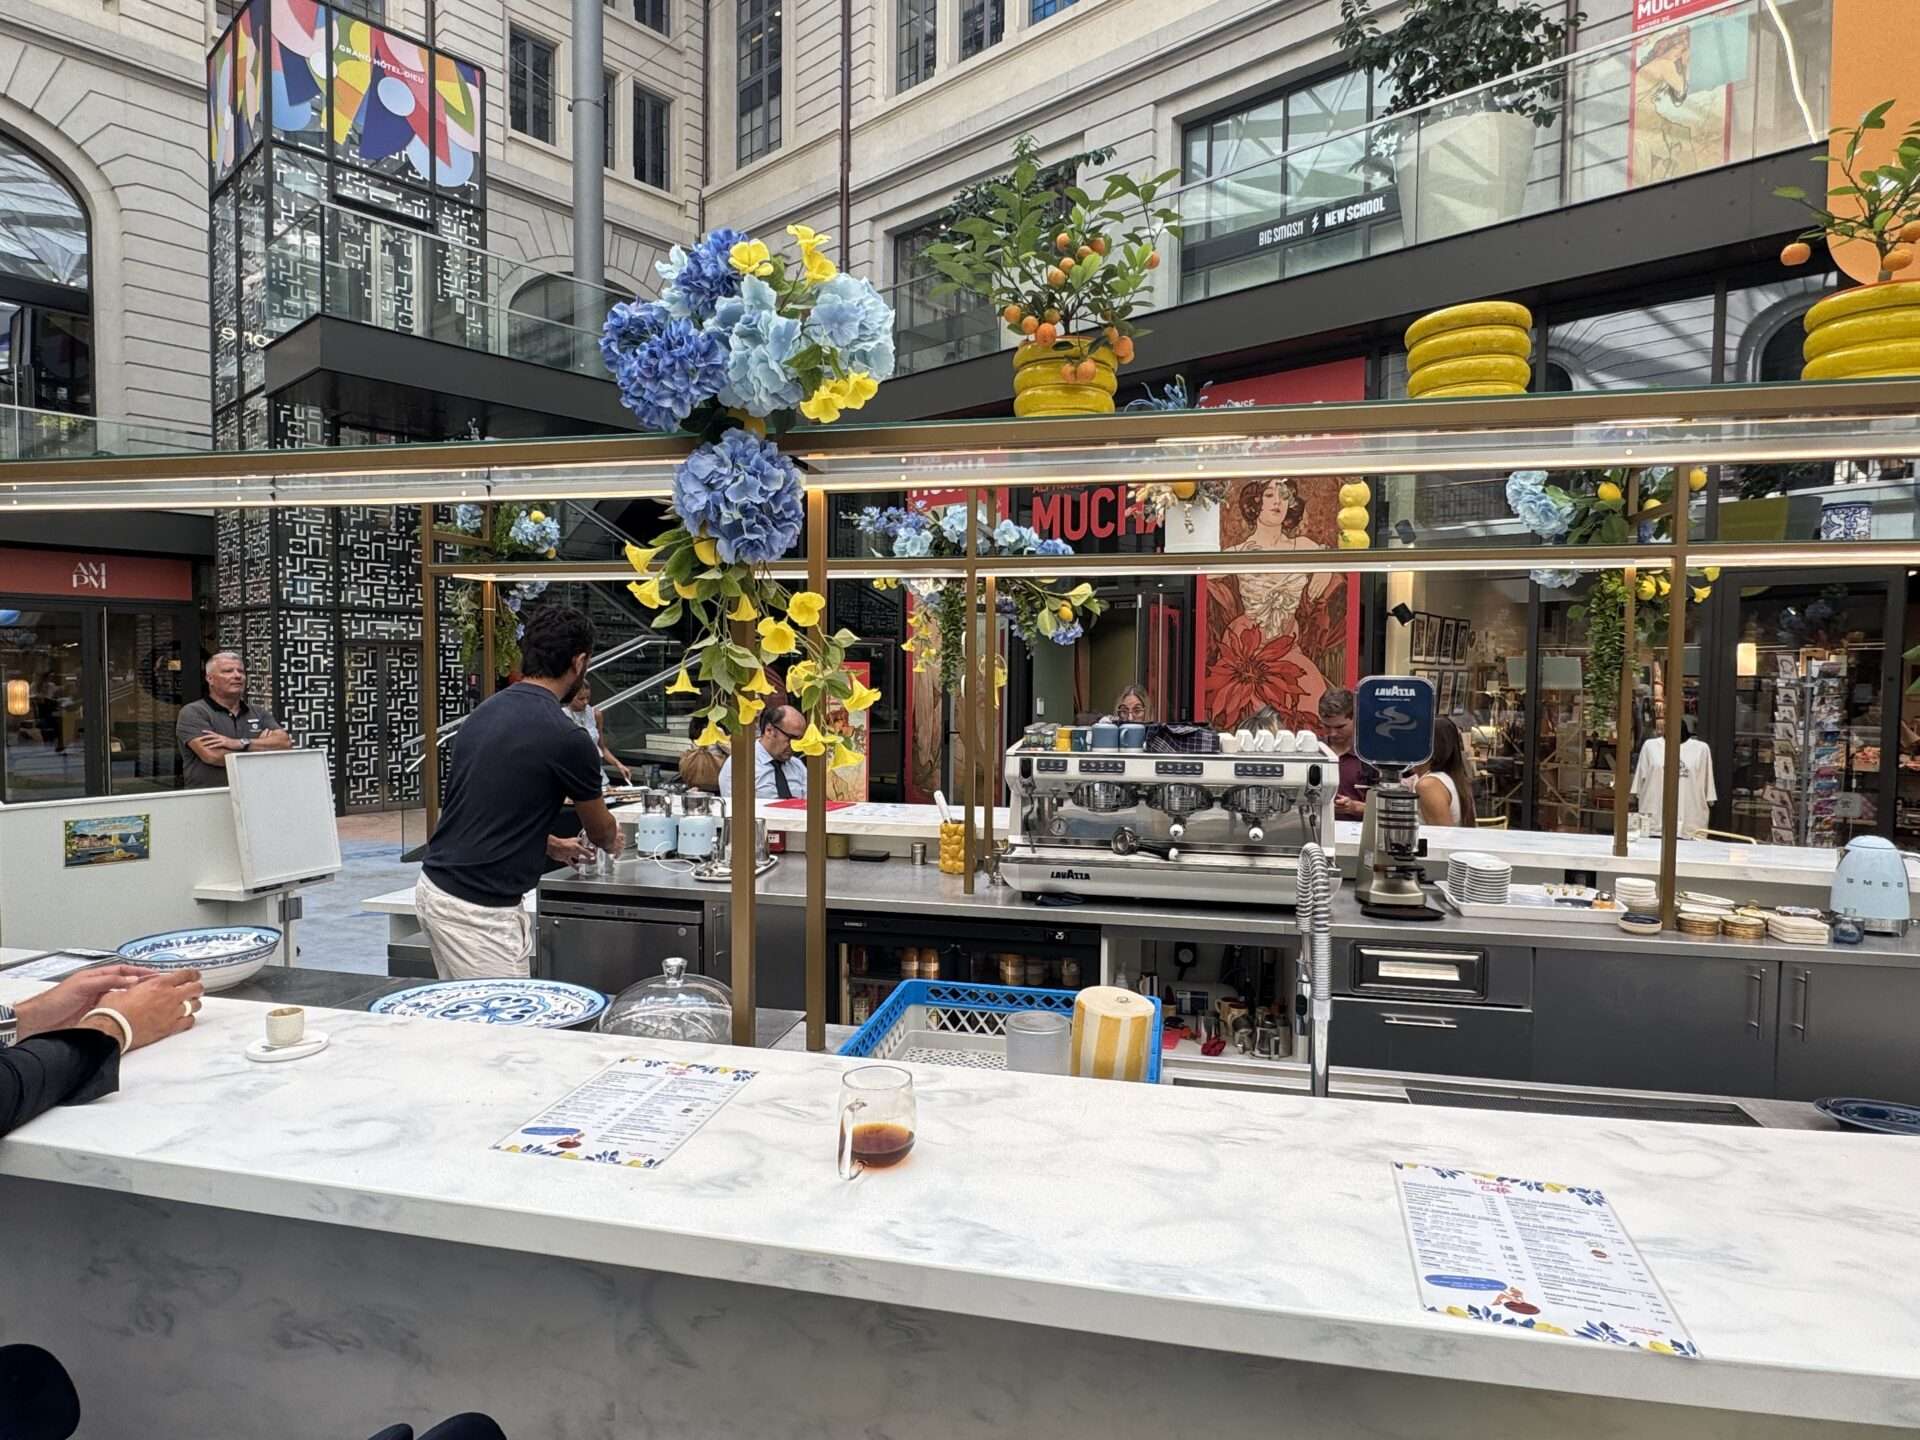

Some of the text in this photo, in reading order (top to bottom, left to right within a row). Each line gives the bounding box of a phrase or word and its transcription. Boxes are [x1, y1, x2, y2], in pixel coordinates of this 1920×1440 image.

[1637, 0, 1691, 20] MUC
[338, 44, 424, 84] GRAND HÔTEL-DIEU
[1259, 197, 1386, 246] BIG SMASH NEW SCHOOL
[72, 562, 106, 575] AM
[72, 574, 106, 589] PM
[1374, 685, 1416, 697] LAVAZZA
[1050, 869, 1091, 881] LAVAZZA
